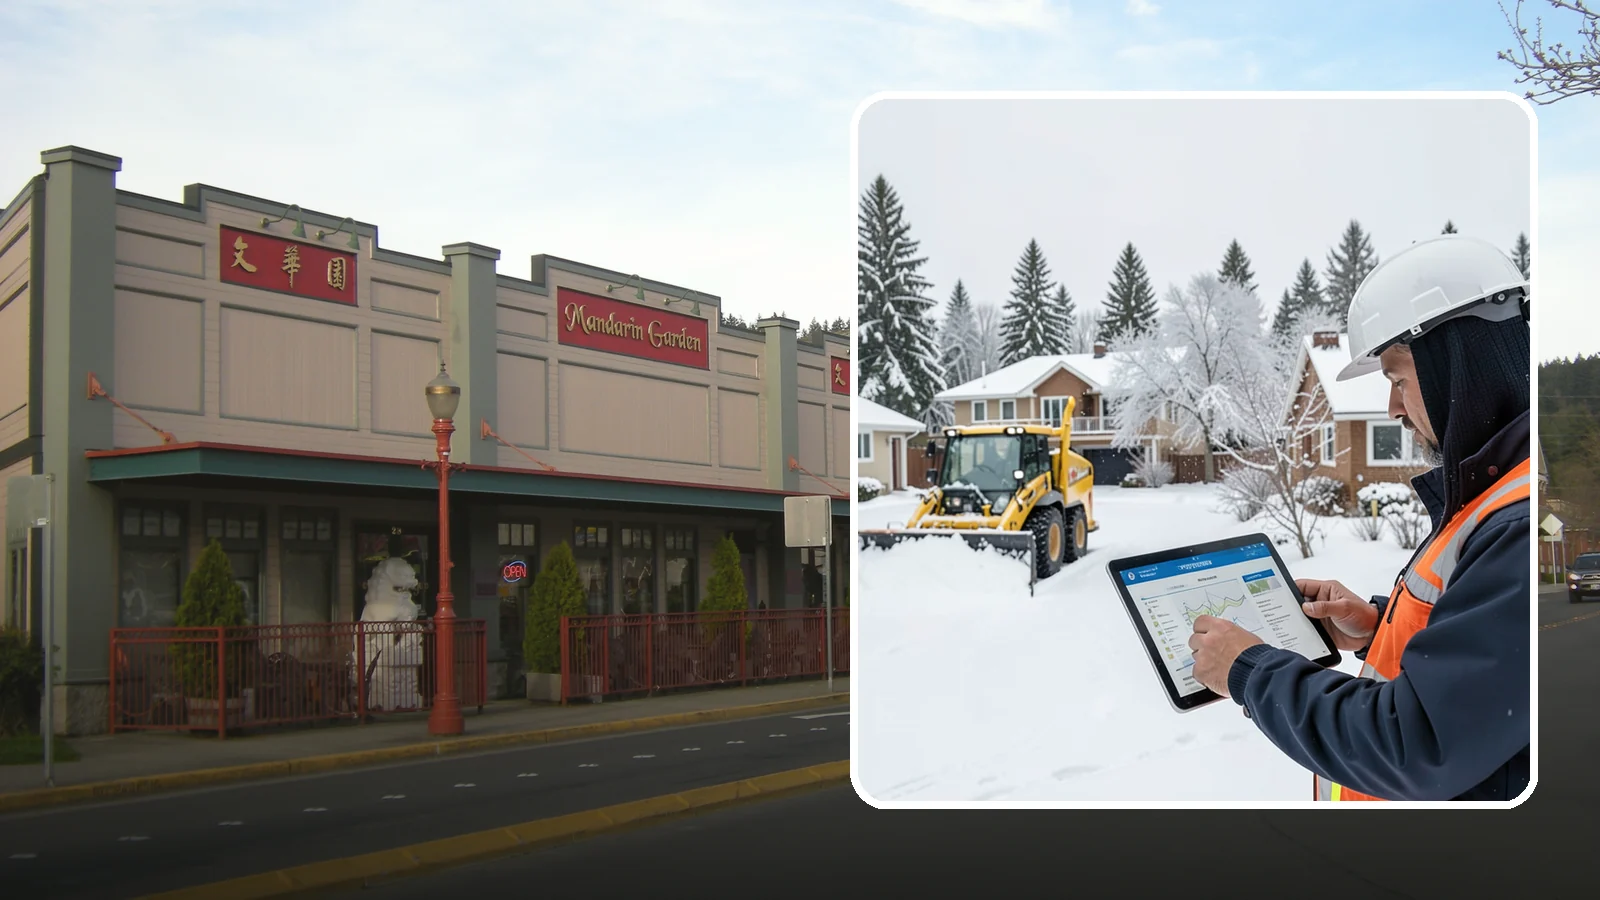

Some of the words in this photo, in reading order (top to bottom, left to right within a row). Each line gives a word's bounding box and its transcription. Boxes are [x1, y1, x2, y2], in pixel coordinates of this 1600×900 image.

[231, 236, 346, 290] 文華園
[564, 302, 644, 340] Mandarin
[647, 320, 701, 352] Garden
[503, 565, 527, 578] OPEN
